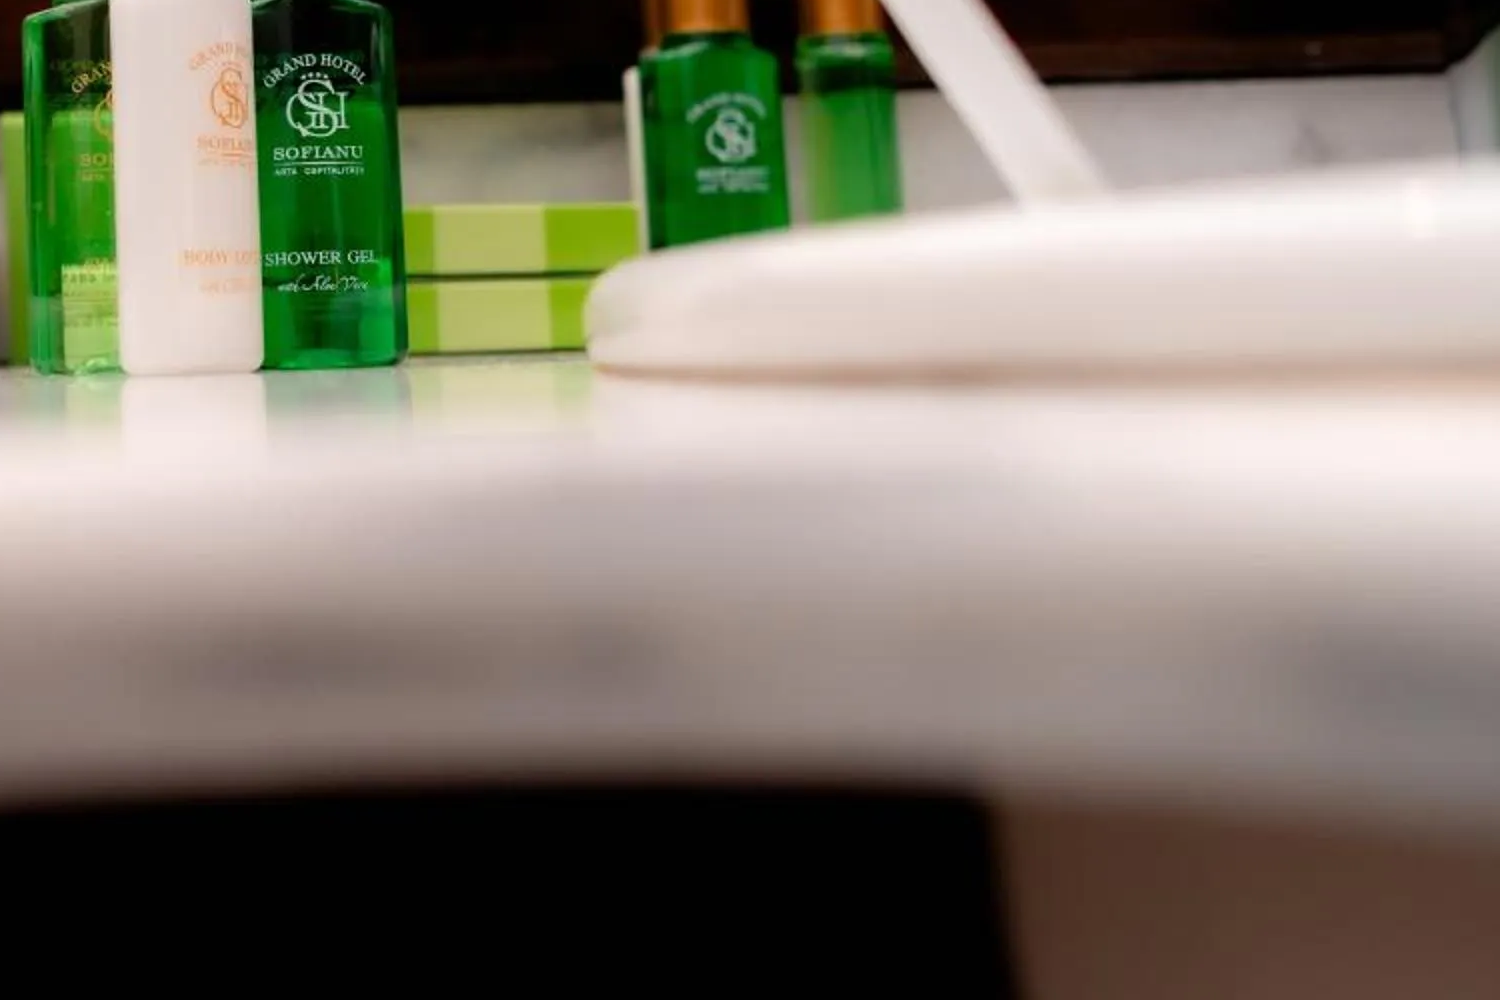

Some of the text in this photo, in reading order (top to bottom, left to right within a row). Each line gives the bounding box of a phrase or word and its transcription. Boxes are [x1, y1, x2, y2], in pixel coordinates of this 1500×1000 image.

[263, 53, 317, 88] GRAND
[321, 53, 367, 86] HOTEL
[273, 145, 363, 161] SOFIANU
[265, 250, 378, 267] SHOWER GEL
